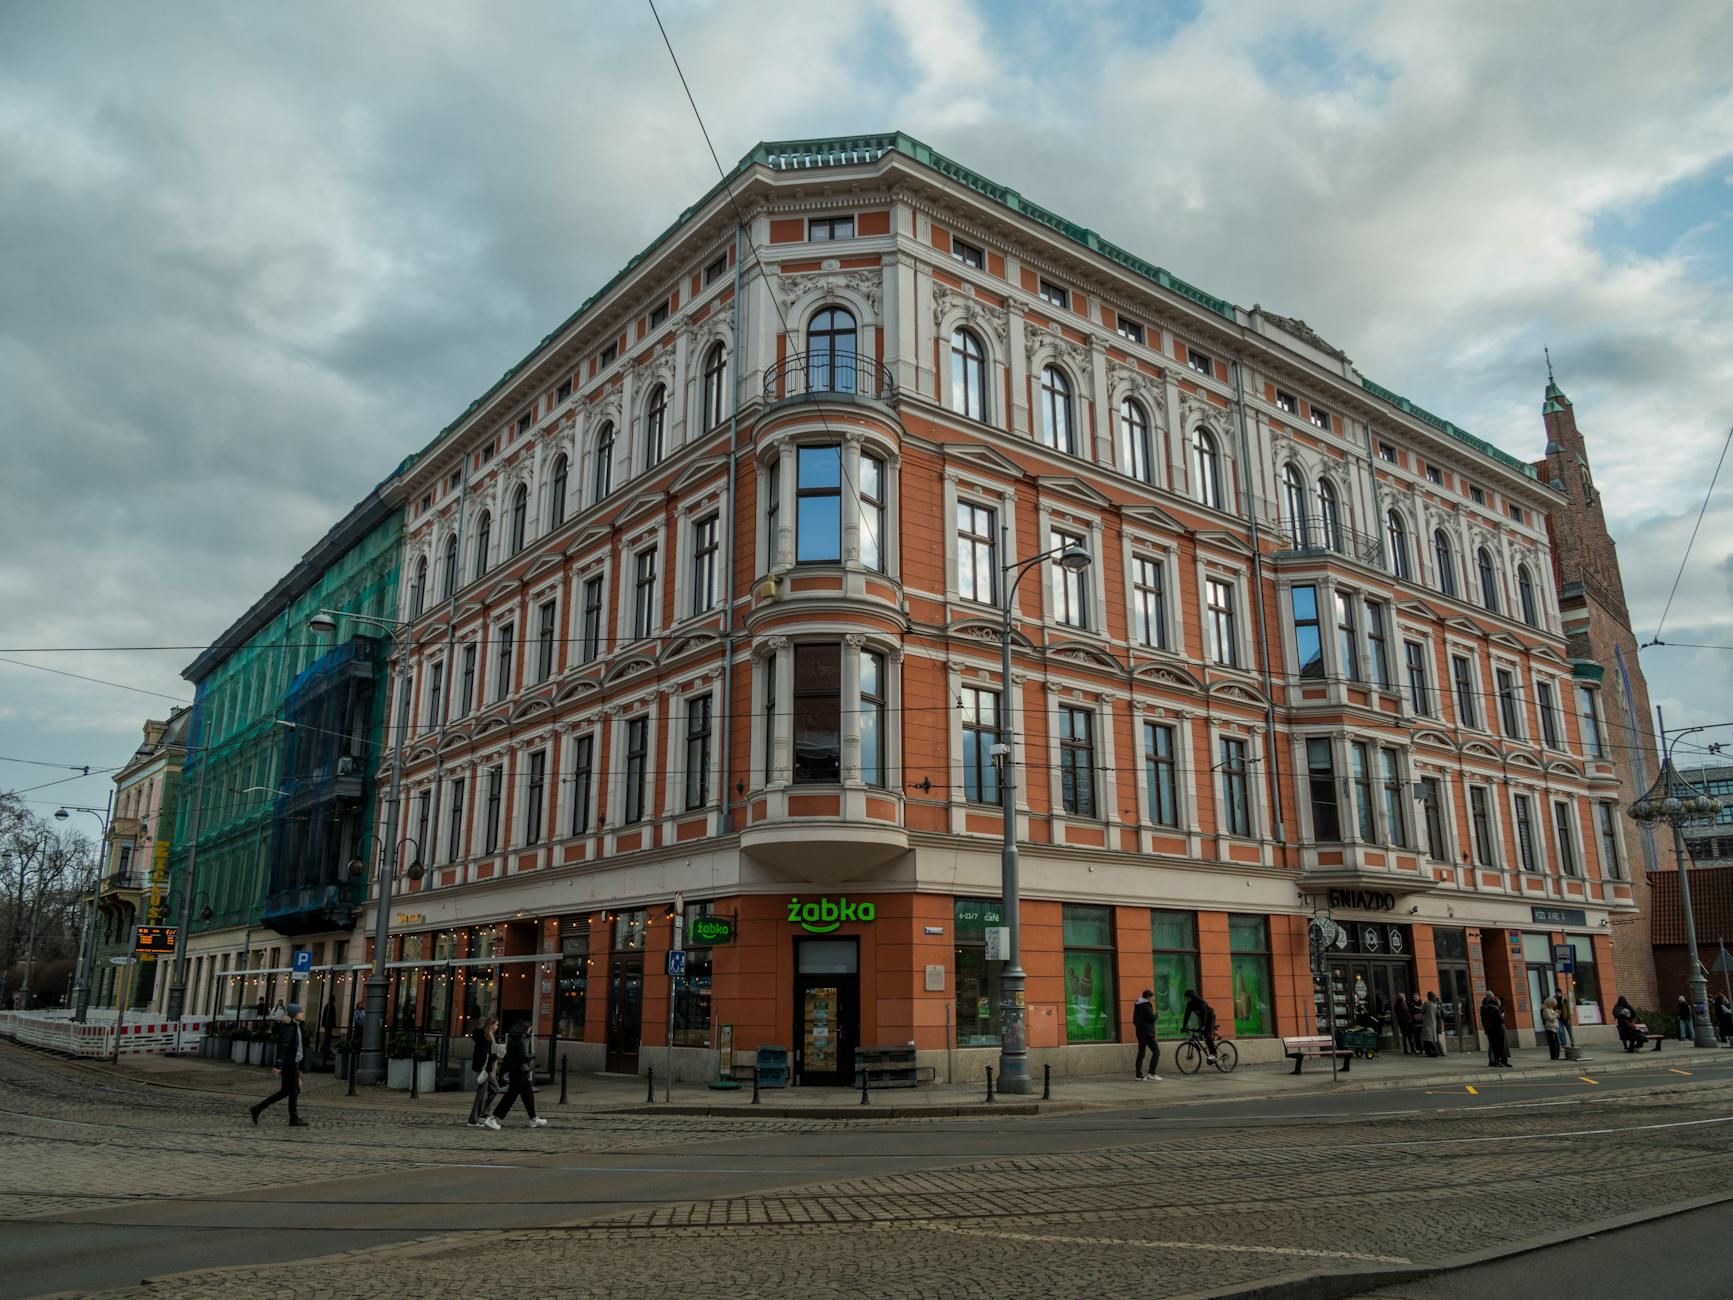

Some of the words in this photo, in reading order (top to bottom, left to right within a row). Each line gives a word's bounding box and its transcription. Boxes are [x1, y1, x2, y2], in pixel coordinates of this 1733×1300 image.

[1329, 889, 1395, 910] GNIAZDO
[787, 897, 875, 922] żabka
[958, 912, 978, 921] 6-23/7
[697, 921, 729, 935] żabka
[297, 953, 309, 966] P
